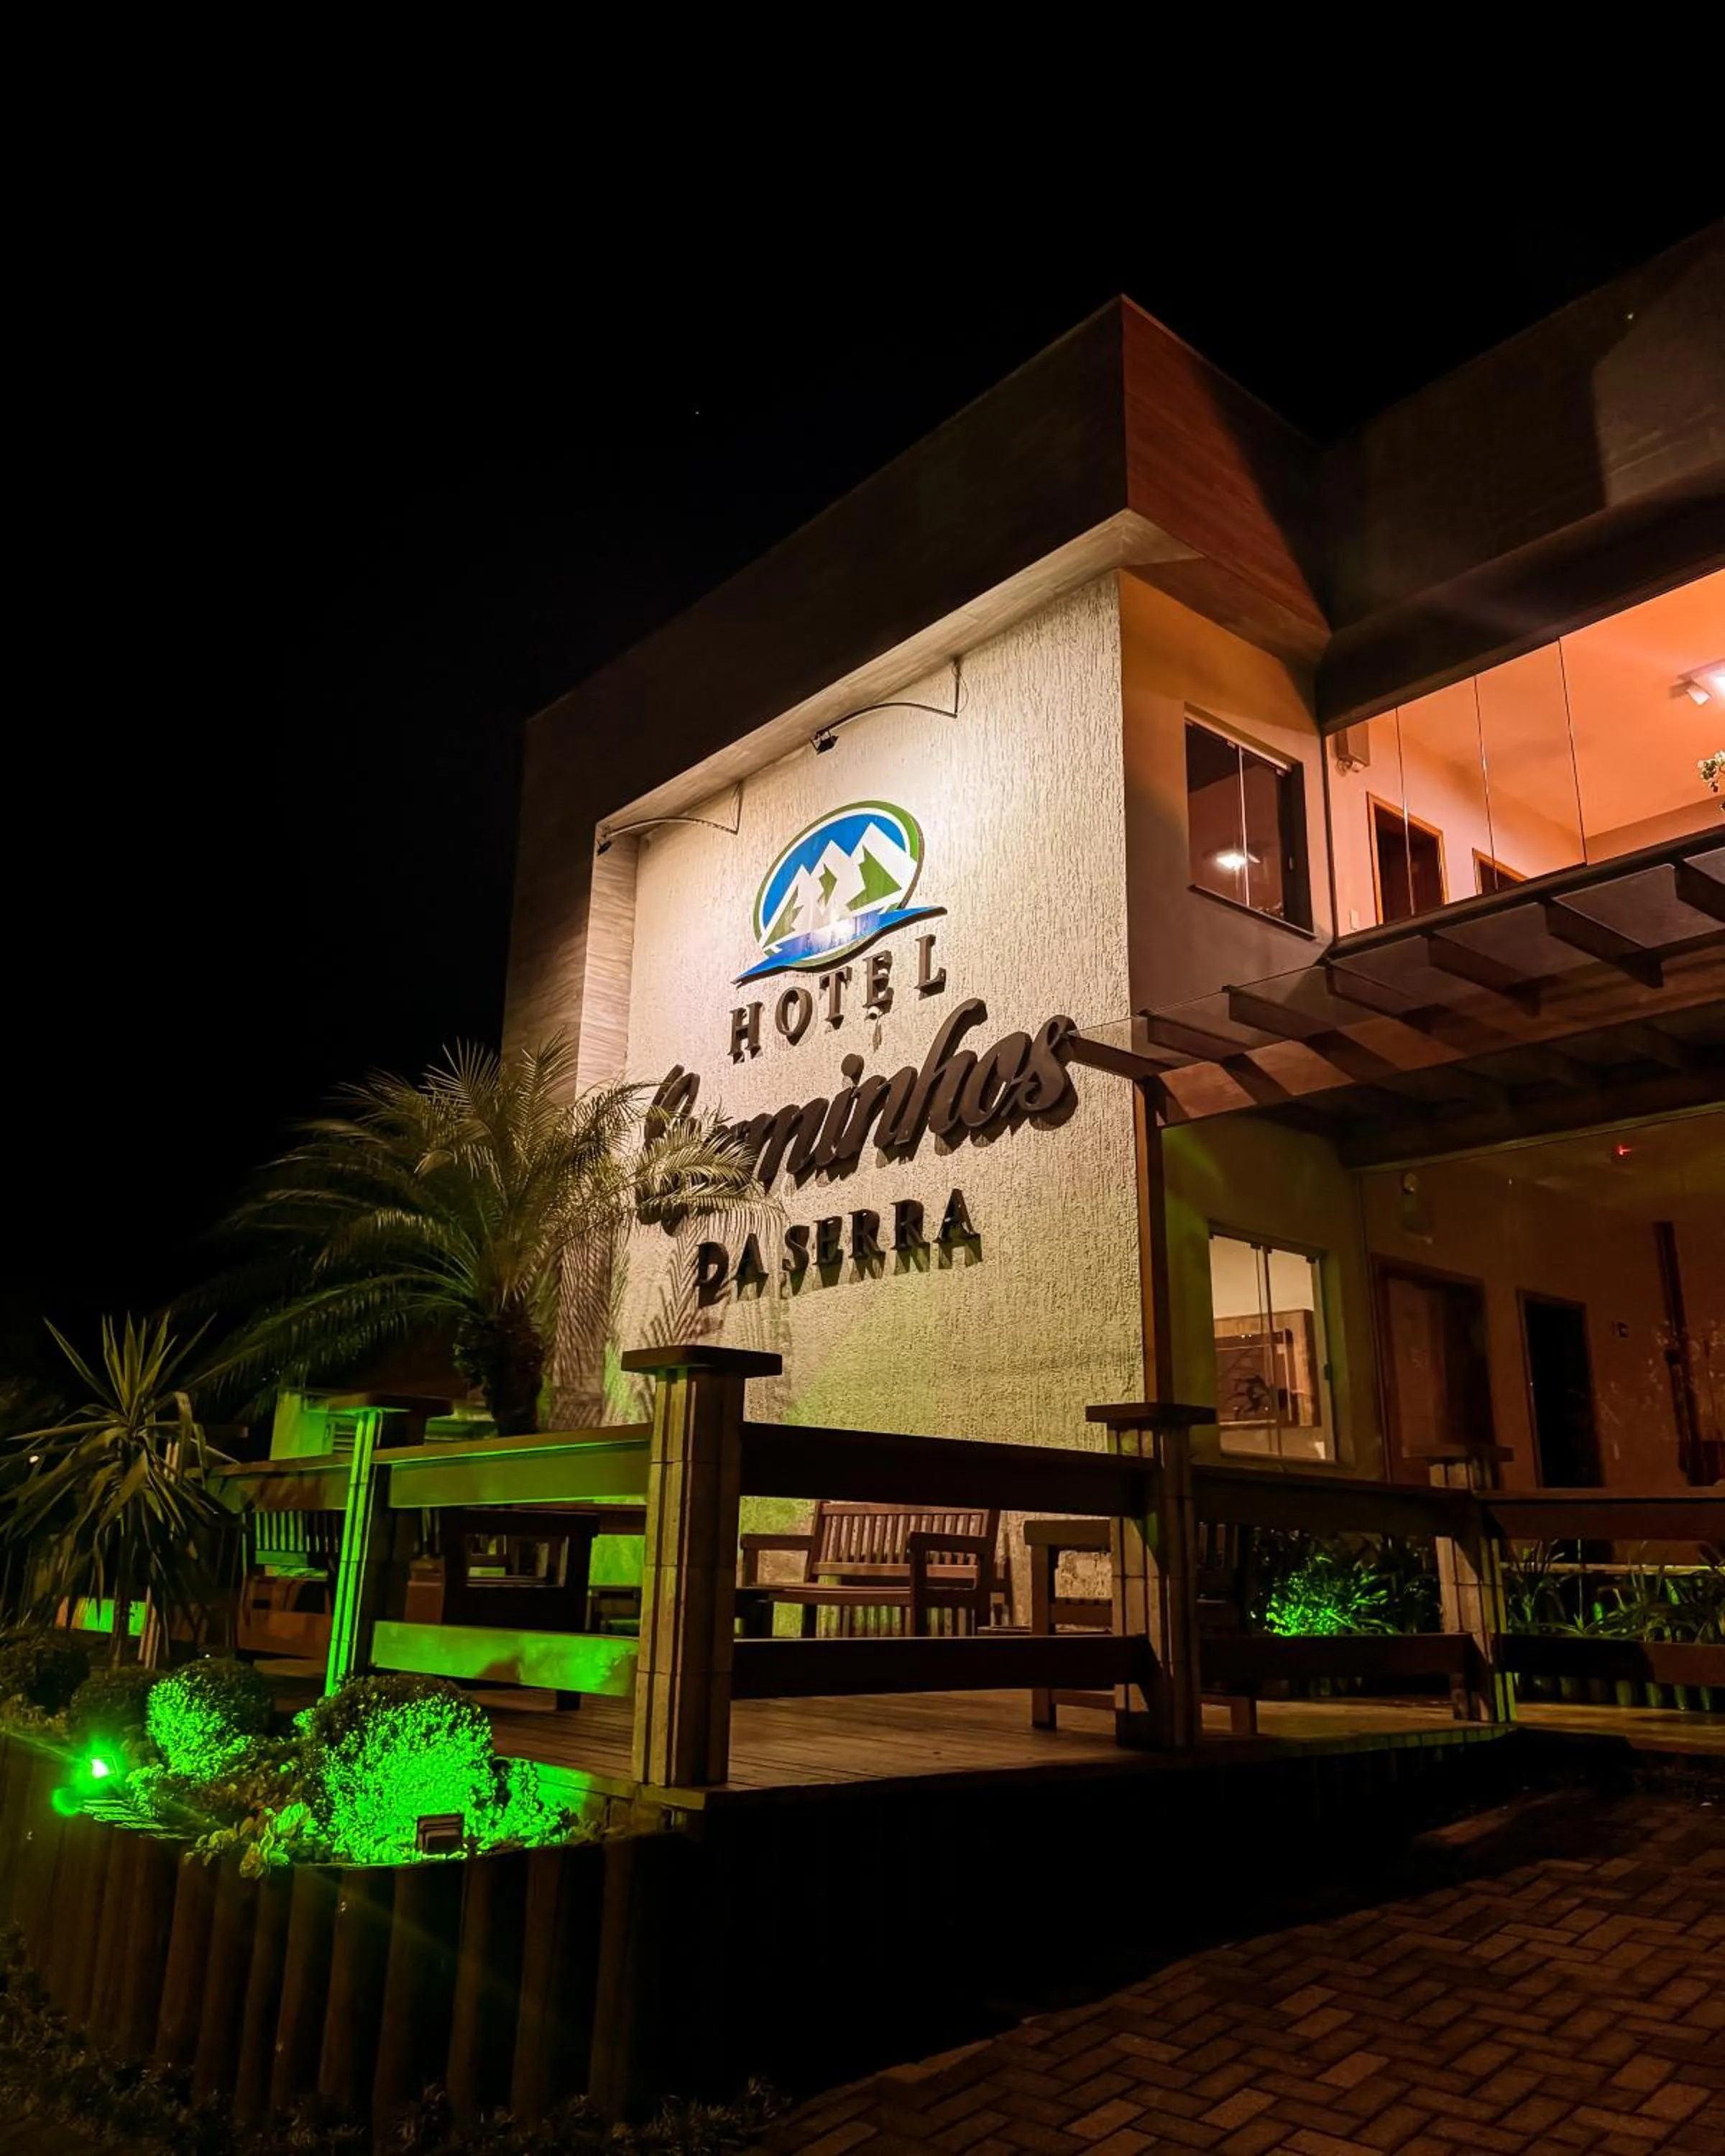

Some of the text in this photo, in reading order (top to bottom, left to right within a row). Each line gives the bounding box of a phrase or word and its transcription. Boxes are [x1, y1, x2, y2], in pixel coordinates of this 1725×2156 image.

[727, 934, 947, 1056] HOTEL
[696, 1188, 979, 1288] DA SERRA
